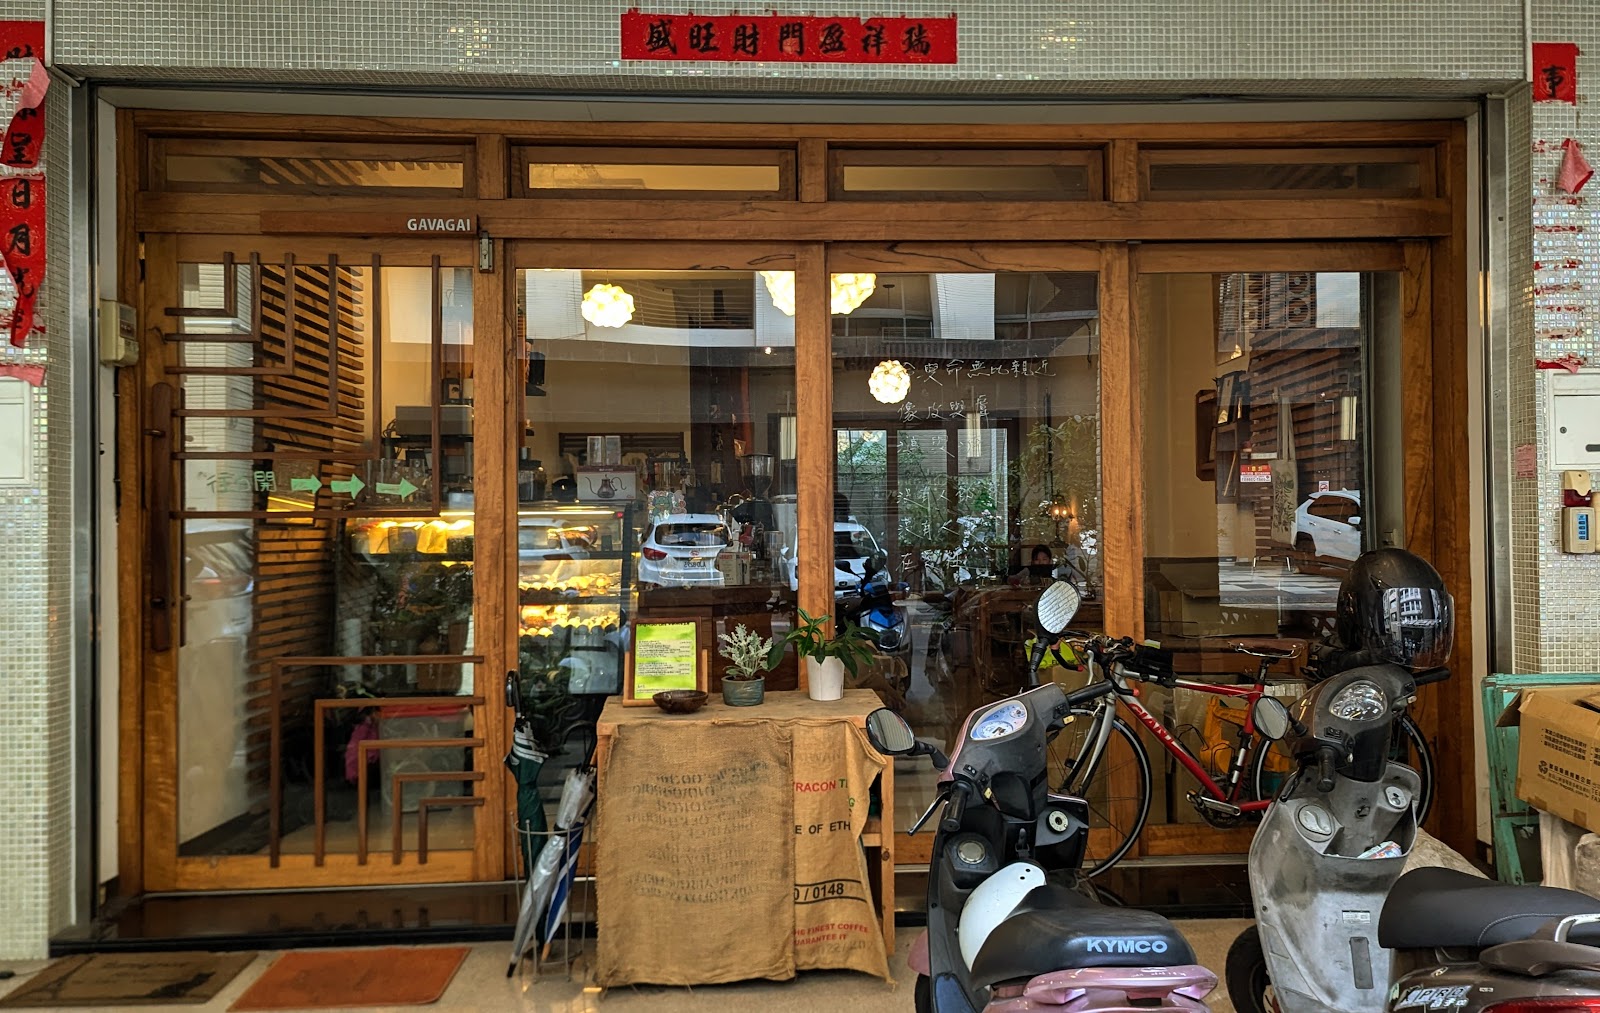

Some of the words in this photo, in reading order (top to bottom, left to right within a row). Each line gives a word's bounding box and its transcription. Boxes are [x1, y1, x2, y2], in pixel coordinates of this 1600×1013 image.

[407, 218, 471, 231] GAVAGAI
[1127, 702, 1175, 746] GIANT
[793, 780, 836, 792] RACON
[808, 824, 823, 834] OF
[830, 820, 851, 831] ETH
[804, 888, 809, 900] /
[813, 882, 844, 899] 0148
[808, 923, 835, 935] FINEST
[837, 923, 868, 933] COFFEE
[1086, 939, 1168, 953] KYMCO
